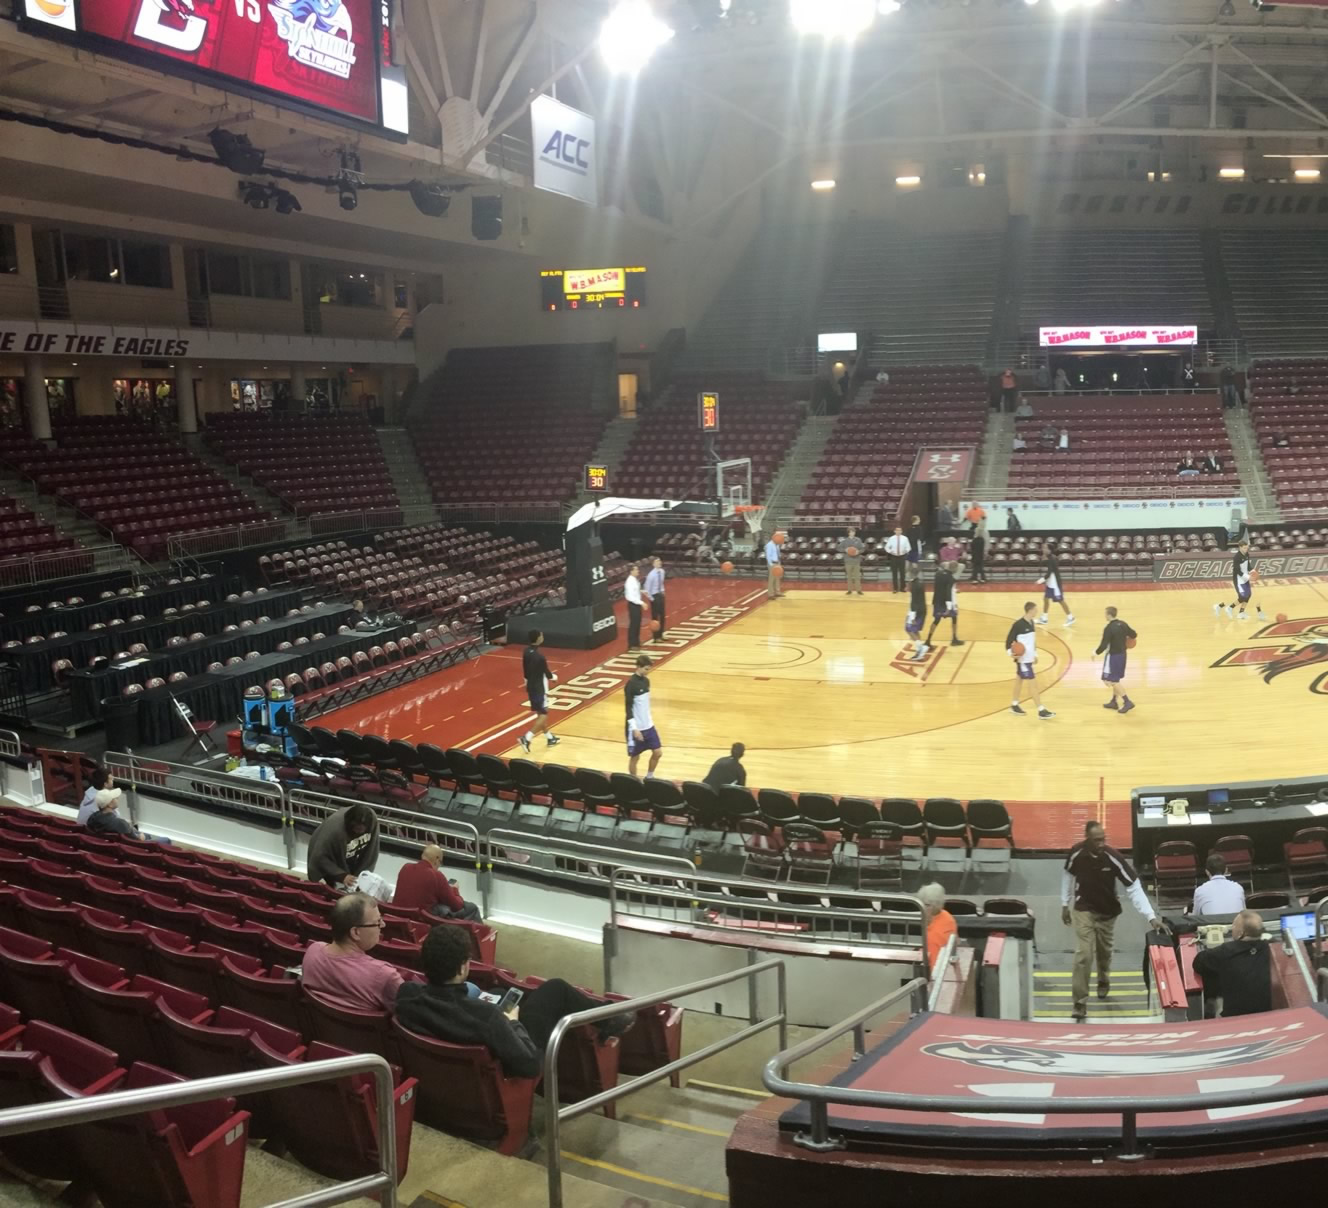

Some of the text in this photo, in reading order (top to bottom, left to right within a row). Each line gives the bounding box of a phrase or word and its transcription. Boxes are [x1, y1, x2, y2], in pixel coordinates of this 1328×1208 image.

[542, 130, 591, 168] ACC
[24, 333, 58, 352] OF
[65, 334, 106, 353] THE
[112, 336, 190, 356] EAGLES
[703, 408, 715, 427] 30
[591, 477, 603, 487] 30
[593, 616, 616, 632] GEICO
[643, 605, 750, 649] COLLEGE
